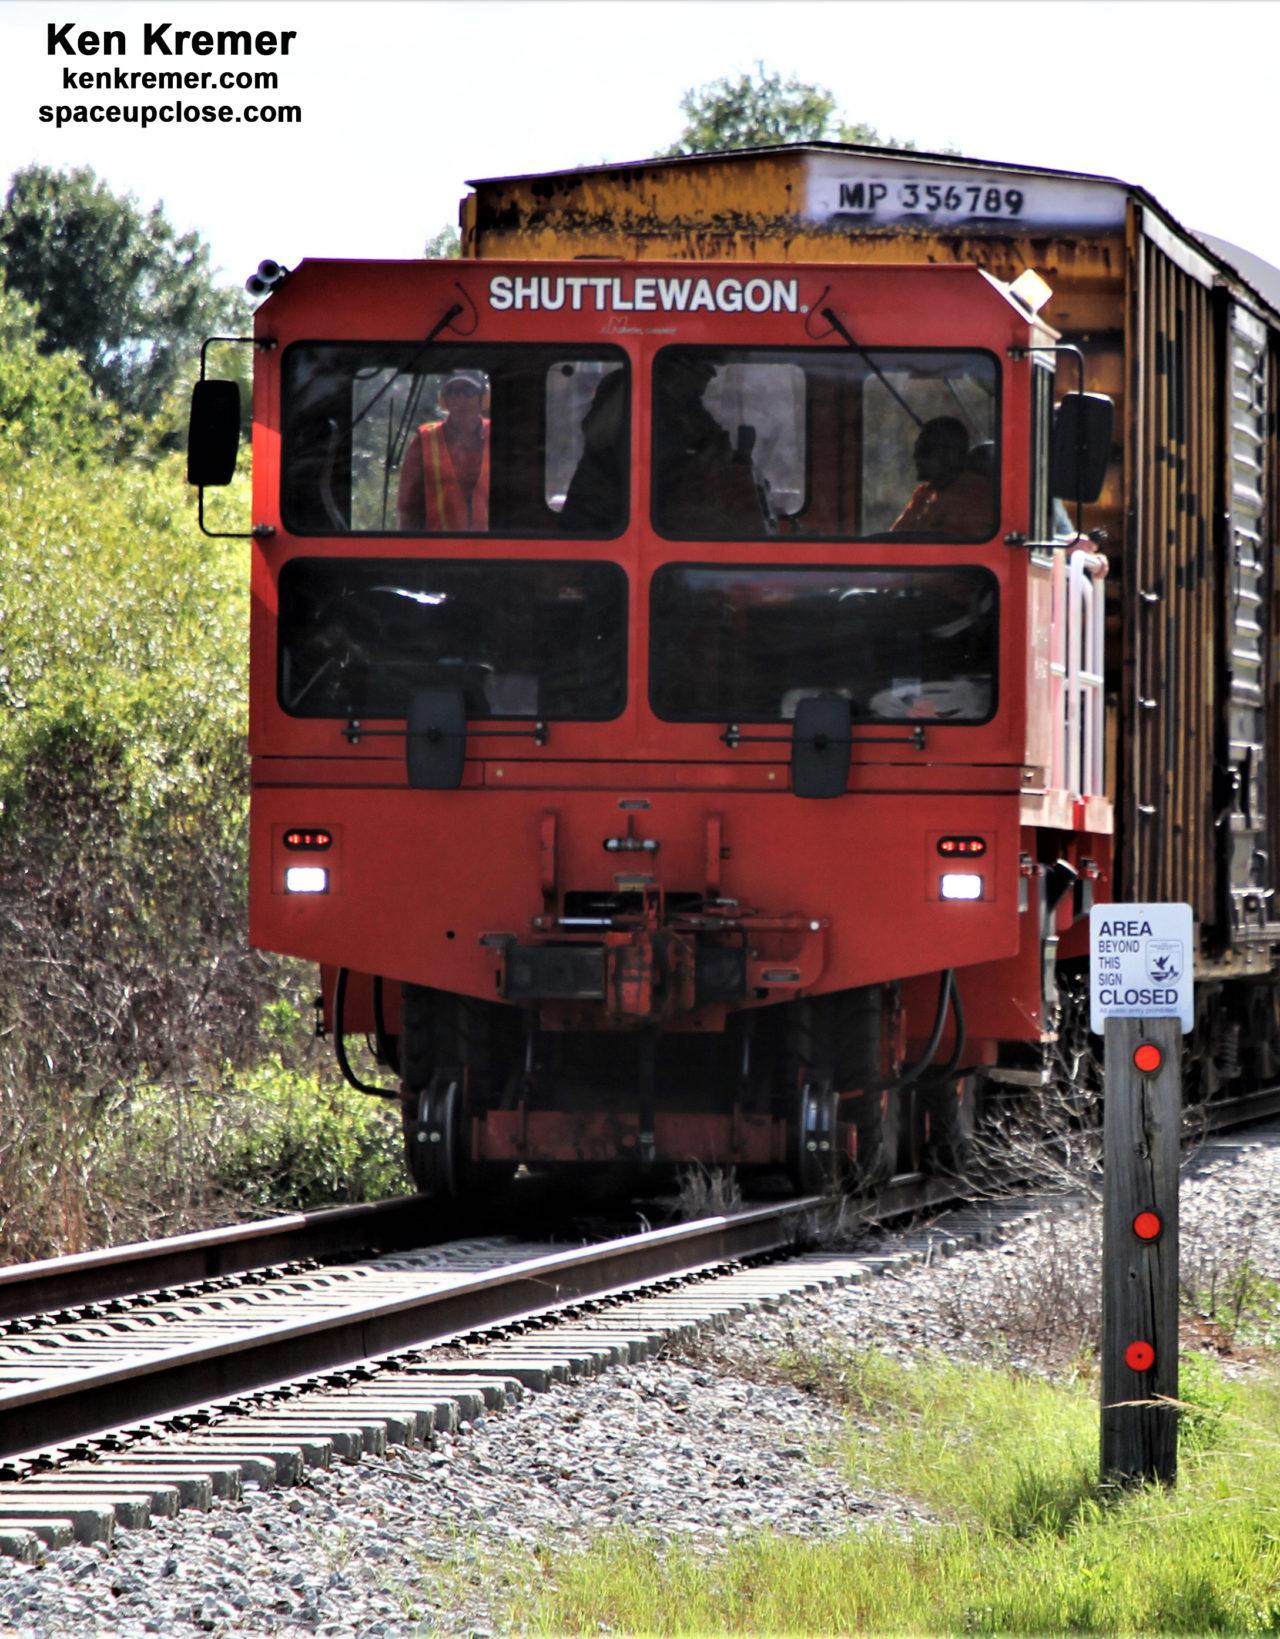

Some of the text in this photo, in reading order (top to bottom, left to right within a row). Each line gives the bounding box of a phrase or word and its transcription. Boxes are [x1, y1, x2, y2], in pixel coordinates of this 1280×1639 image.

[839, 182, 1025, 215] MP 356789
[1099, 921, 1153, 937] AREA
[1098, 940, 1140, 953] BEYOND
[1098, 956, 1121, 970] THIS
[1098, 973, 1122, 986] SIGN
[1099, 989, 1179, 1006] CLOSED
